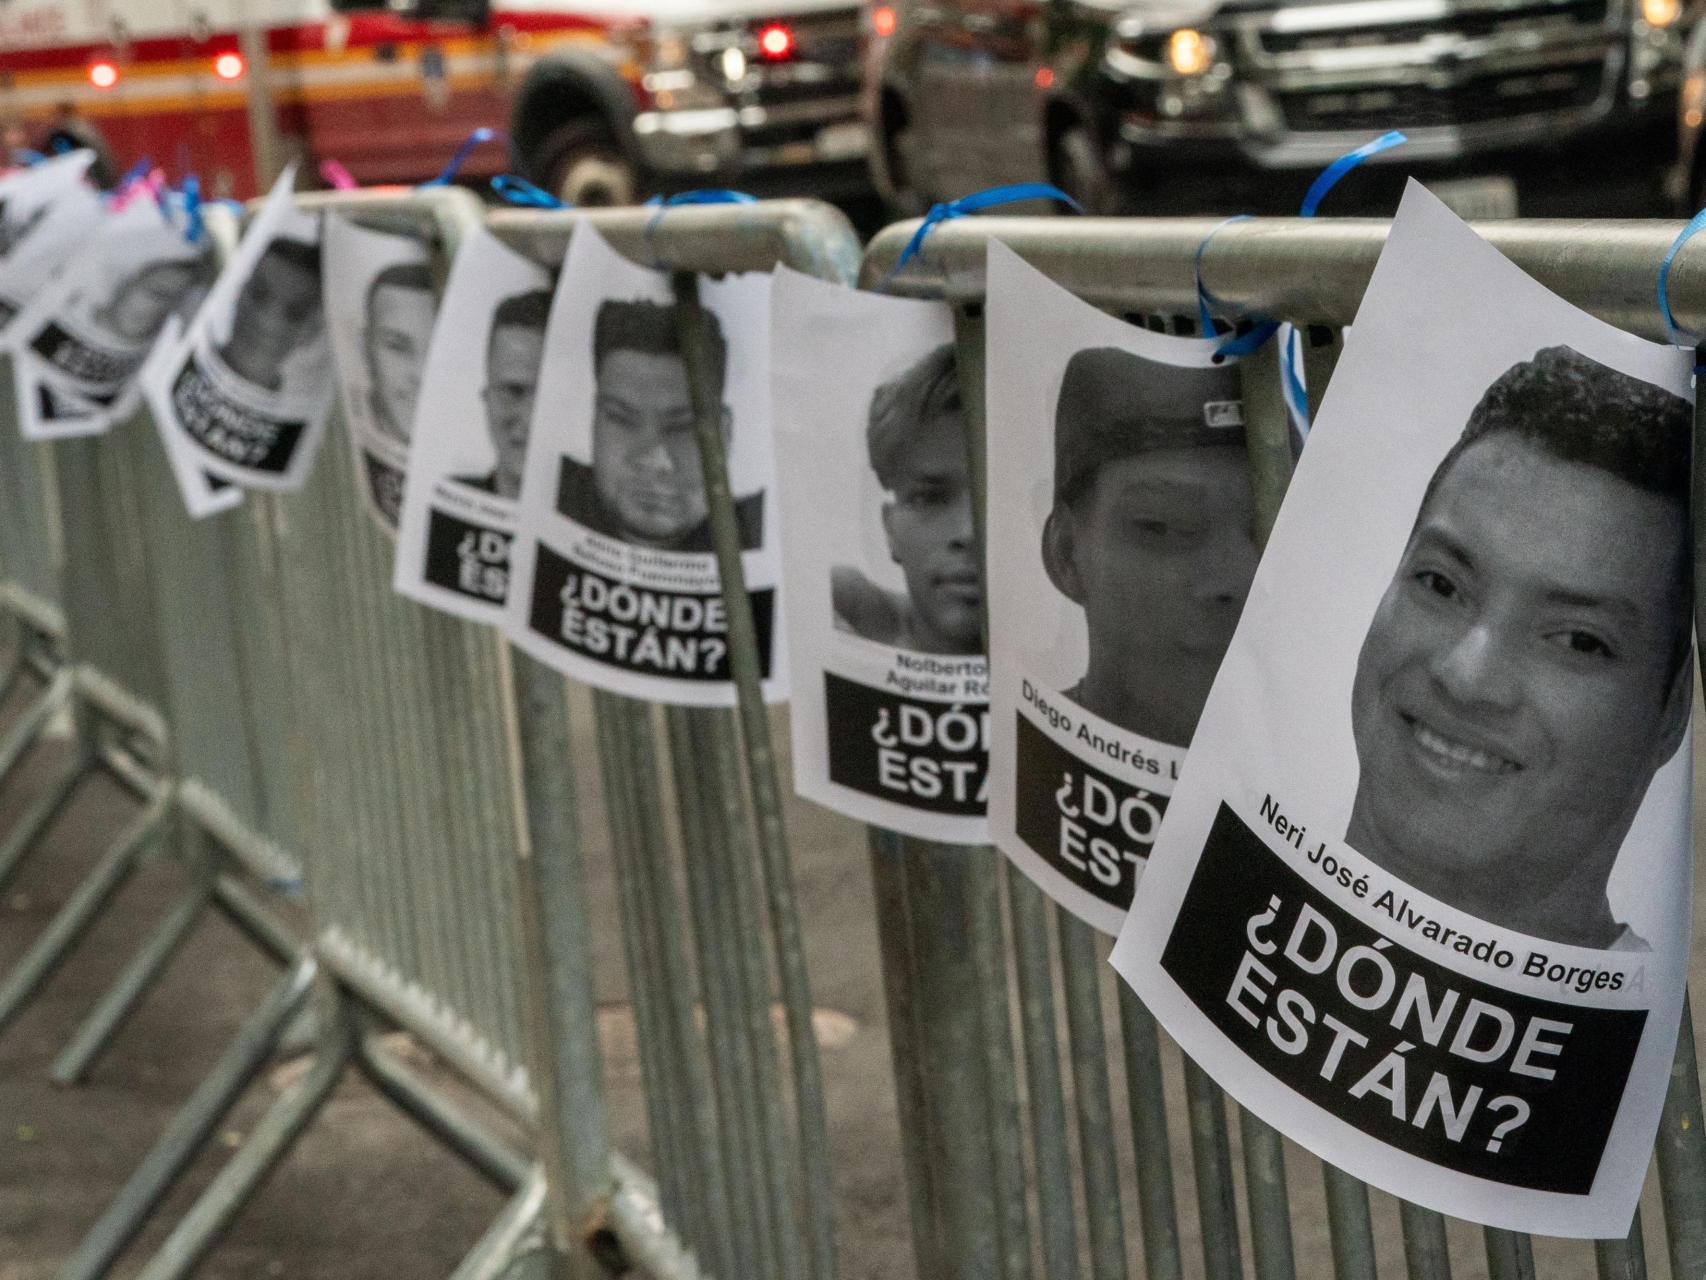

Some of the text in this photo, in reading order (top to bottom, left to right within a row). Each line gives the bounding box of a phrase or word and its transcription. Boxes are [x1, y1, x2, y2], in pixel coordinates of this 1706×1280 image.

[560, 573, 728, 633] ¿DÓNDE
[561, 606, 727, 673] ESTÁN?
[886, 670, 956, 694] Aguilar
[896, 654, 986, 676] Nolberto
[1022, 678, 1072, 731] Diego
[1076, 723, 1160, 775] Andrés
[1259, 793, 1307, 849] Neri
[1308, 843, 1369, 898] José
[1372, 890, 1514, 969] Alvarado
[1522, 952, 1625, 993] Borges
[1246, 893, 1574, 1081] ¿DÓNDE
[1225, 950, 1531, 1154] ESTÁN?
